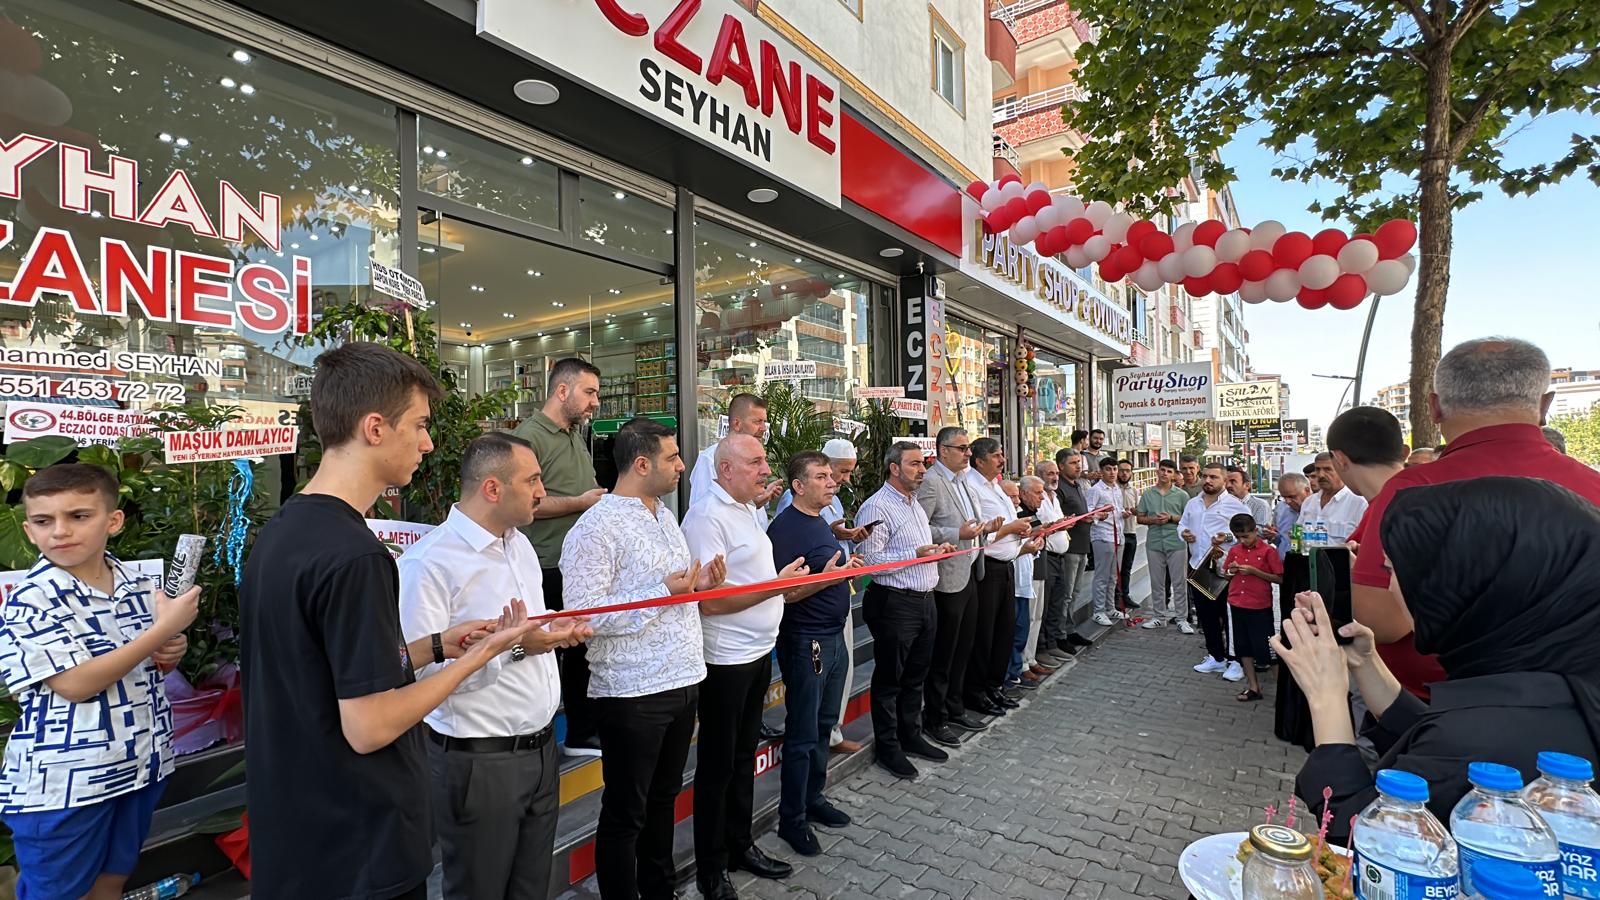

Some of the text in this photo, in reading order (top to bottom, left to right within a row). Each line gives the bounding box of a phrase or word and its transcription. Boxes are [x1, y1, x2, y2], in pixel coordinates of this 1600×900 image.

[639, 58, 771, 163] SEYHAN
[0, 219, 312, 336] ANESİ
[982, 231, 1038, 290] PARTY
[1043, 265, 1079, 312] SHOP
[118, 353, 220, 375] SEYHAN
[60, 380, 109, 398] 453
[119, 383, 147, 400] 72
[155, 384, 184, 402] 72
[1119, 395, 1207, 411] Oyuncak & Organizasyon
[1219, 406, 1277, 418] ERKEK KUAFÖRÜ
[59, 409, 114, 423] 44.BÖLGE
[117, 413, 156, 425] BATMA
[58, 422, 96, 435] ECZACI
[99, 424, 129, 437] ODASI
[89, 436, 117, 446] YERİN
[169, 427, 295, 454] MAŞUK DAMLAYICI
[222, 448, 257, 457] HAYIRLARA
[274, 445, 293, 453] OLSUN
